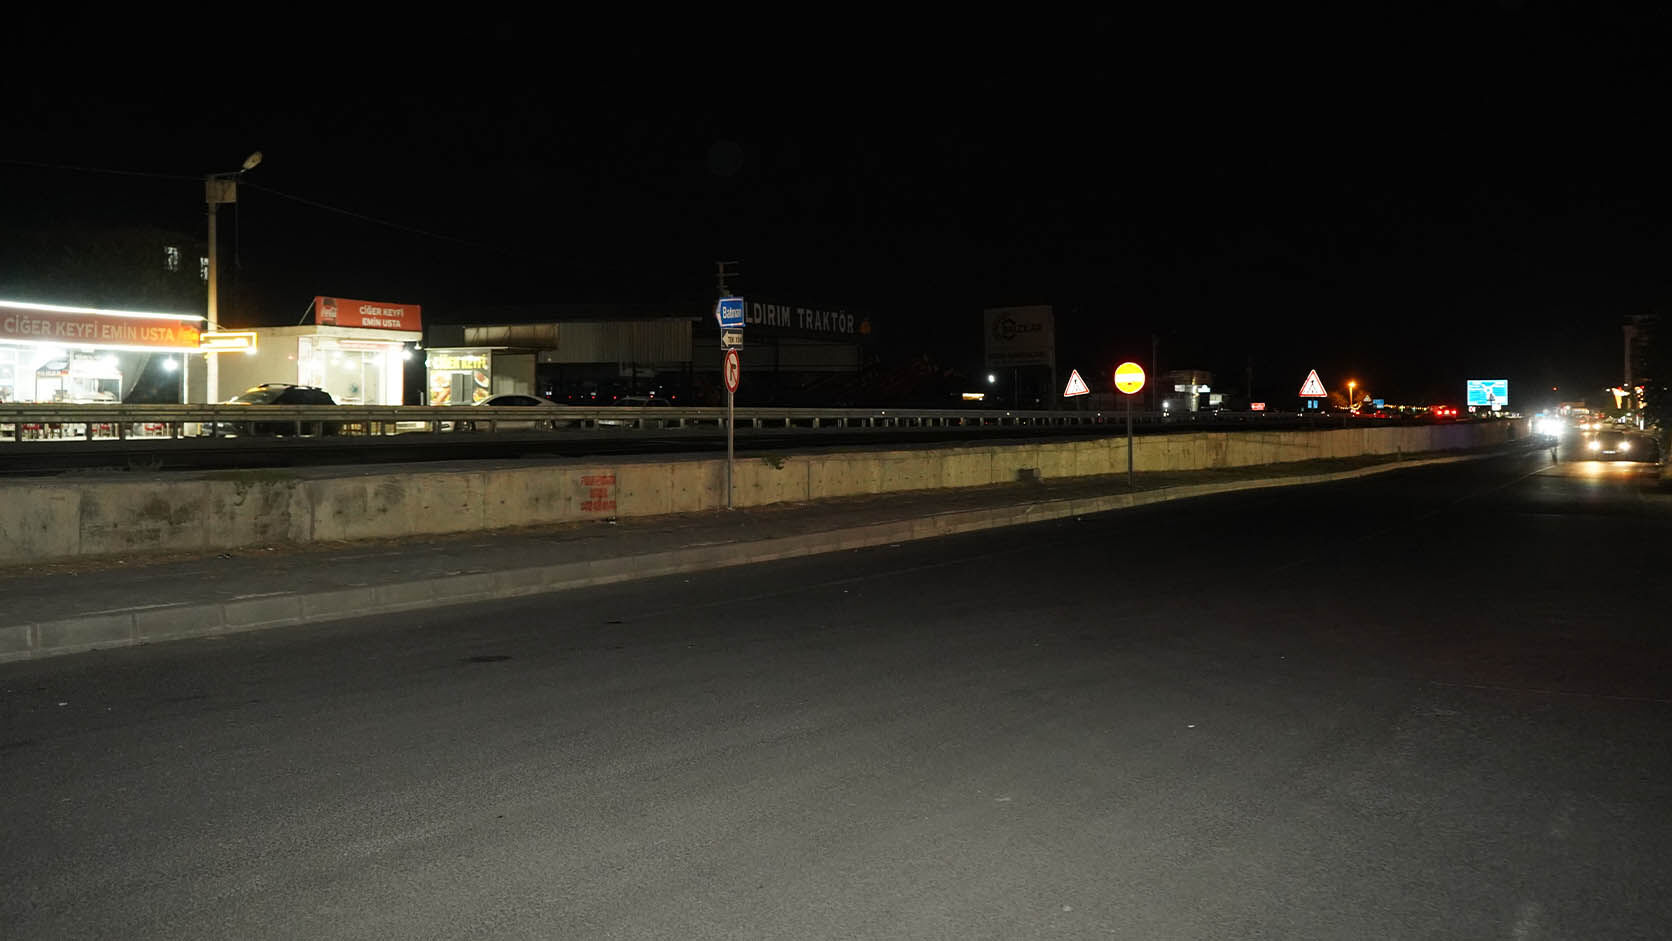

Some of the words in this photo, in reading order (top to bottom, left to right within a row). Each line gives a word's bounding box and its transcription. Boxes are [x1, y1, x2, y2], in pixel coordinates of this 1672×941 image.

[722, 306, 742, 319] Batman
[745, 301, 791, 327] LDIRIM
[797, 308, 854, 333] TRAKTÖR
[4, 314, 53, 334] CİĞER
[56, 320, 98, 338] KEYFİ
[102, 321, 137, 340] EMİN
[140, 327, 175, 342] USTA
[362, 317, 380, 328] EMİN
[382, 319, 401, 329] USTA
